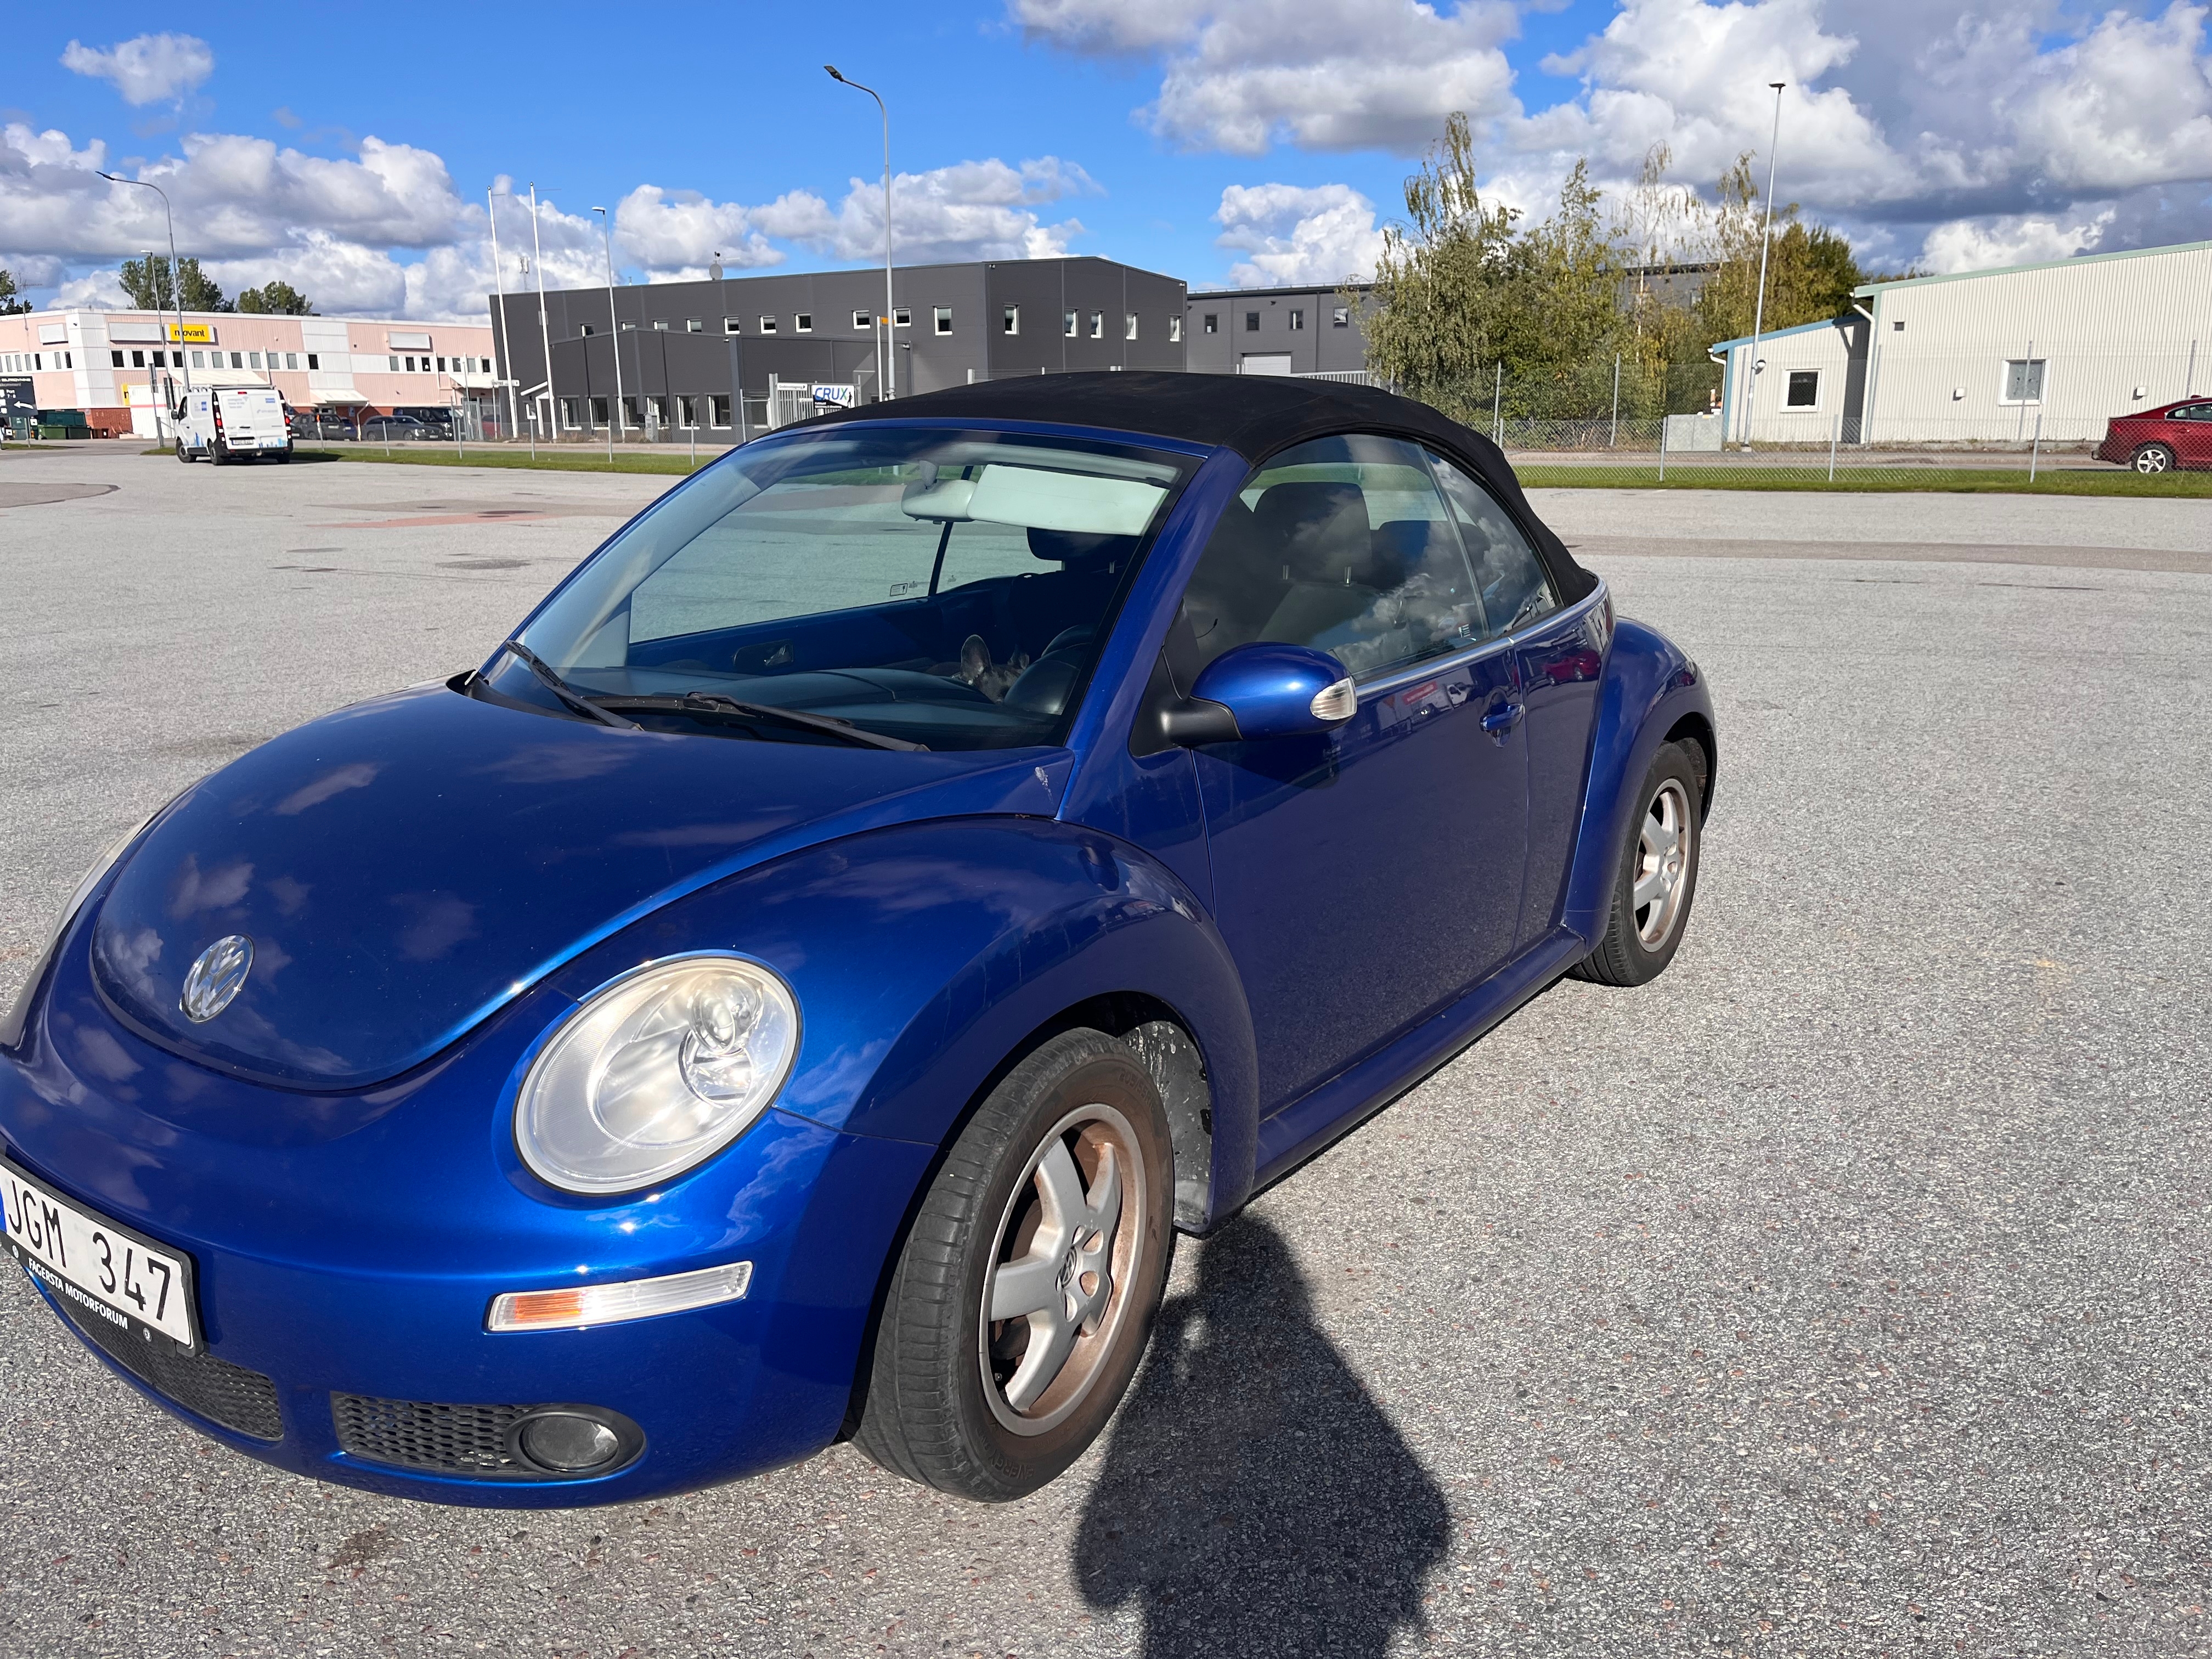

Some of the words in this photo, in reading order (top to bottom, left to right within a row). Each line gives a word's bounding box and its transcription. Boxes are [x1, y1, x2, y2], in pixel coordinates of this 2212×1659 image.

[815, 387, 848, 400] CRUX
[8, 1179, 66, 1268] JGM
[92, 1231, 171, 1321] 347
[28, 1257, 64, 1293] FAGERSTA
[65, 1282, 128, 1330] MOTORFORUM
